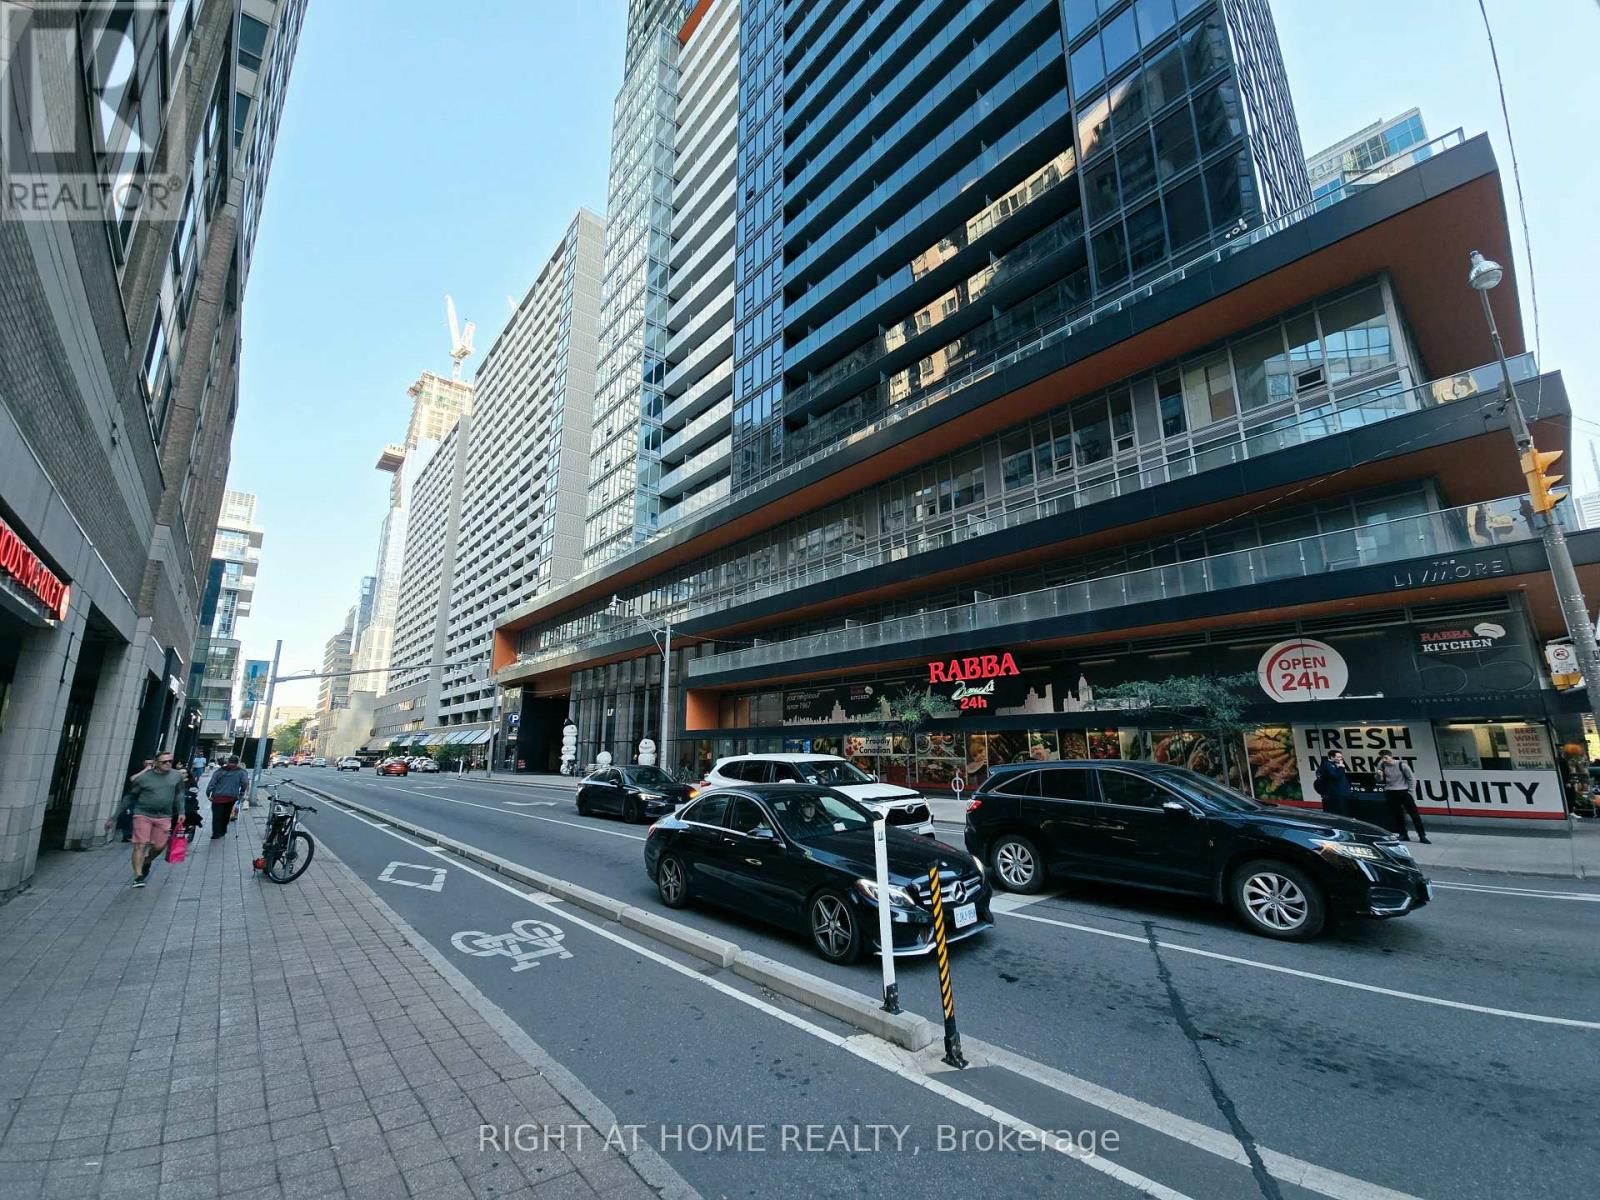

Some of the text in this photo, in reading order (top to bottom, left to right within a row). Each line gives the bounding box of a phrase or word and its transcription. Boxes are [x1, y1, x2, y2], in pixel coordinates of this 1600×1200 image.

[23, 553, 63, 611] MARKET
[1420, 629, 1472, 641] RABBA
[1422, 638, 1493, 652] KITCHEN
[928, 652, 1020, 684] RABBA
[1279, 656, 1327, 671] OPEN
[1281, 671, 1330, 692] 24h
[960, 696, 988, 710] 24h
[865, 736, 891, 746] Proudly
[1304, 727, 1413, 750] FRESH
[1514, 734, 1540, 742] WINE
[859, 746, 891, 754] Canadian
